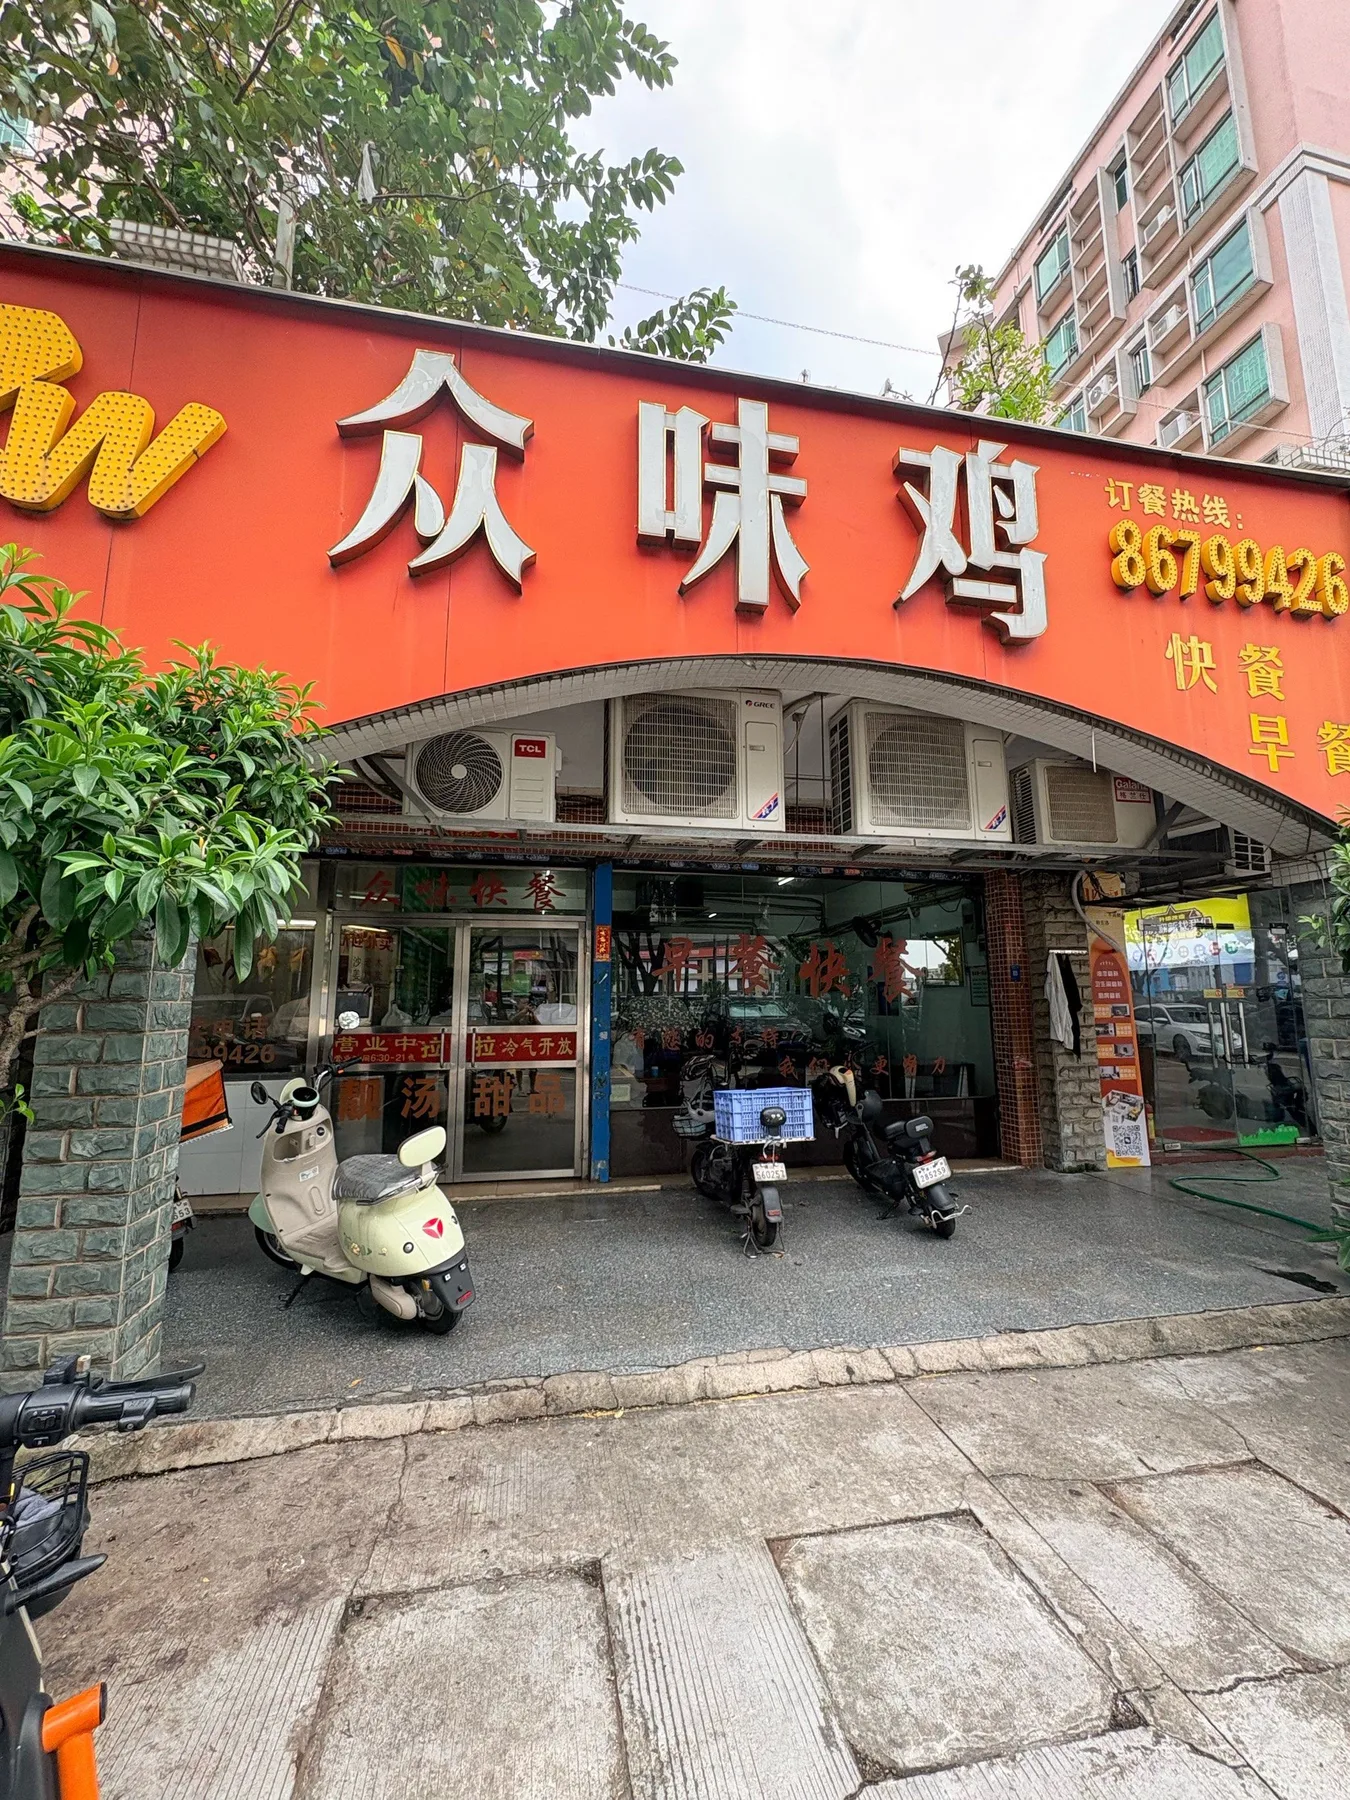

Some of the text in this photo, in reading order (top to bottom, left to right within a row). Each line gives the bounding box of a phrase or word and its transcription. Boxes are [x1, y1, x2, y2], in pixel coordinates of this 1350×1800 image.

[327, 349, 1048, 643] 众味鸡
[1109, 518, 1348, 619] 86799426
[1165, 632, 1286, 701] 快餐
[518, 744, 542, 753] TCL
[1249, 712, 1350, 777] 早餐
[359, 869, 567, 912] 众味快餐
[652, 933, 926, 1003] 早餐快餐
[334, 1036, 443, 1059] 营业中 拉
[475, 1036, 573, 1058] 拉 冷气开放
[337, 1072, 566, 1121] 靓汤甜品
